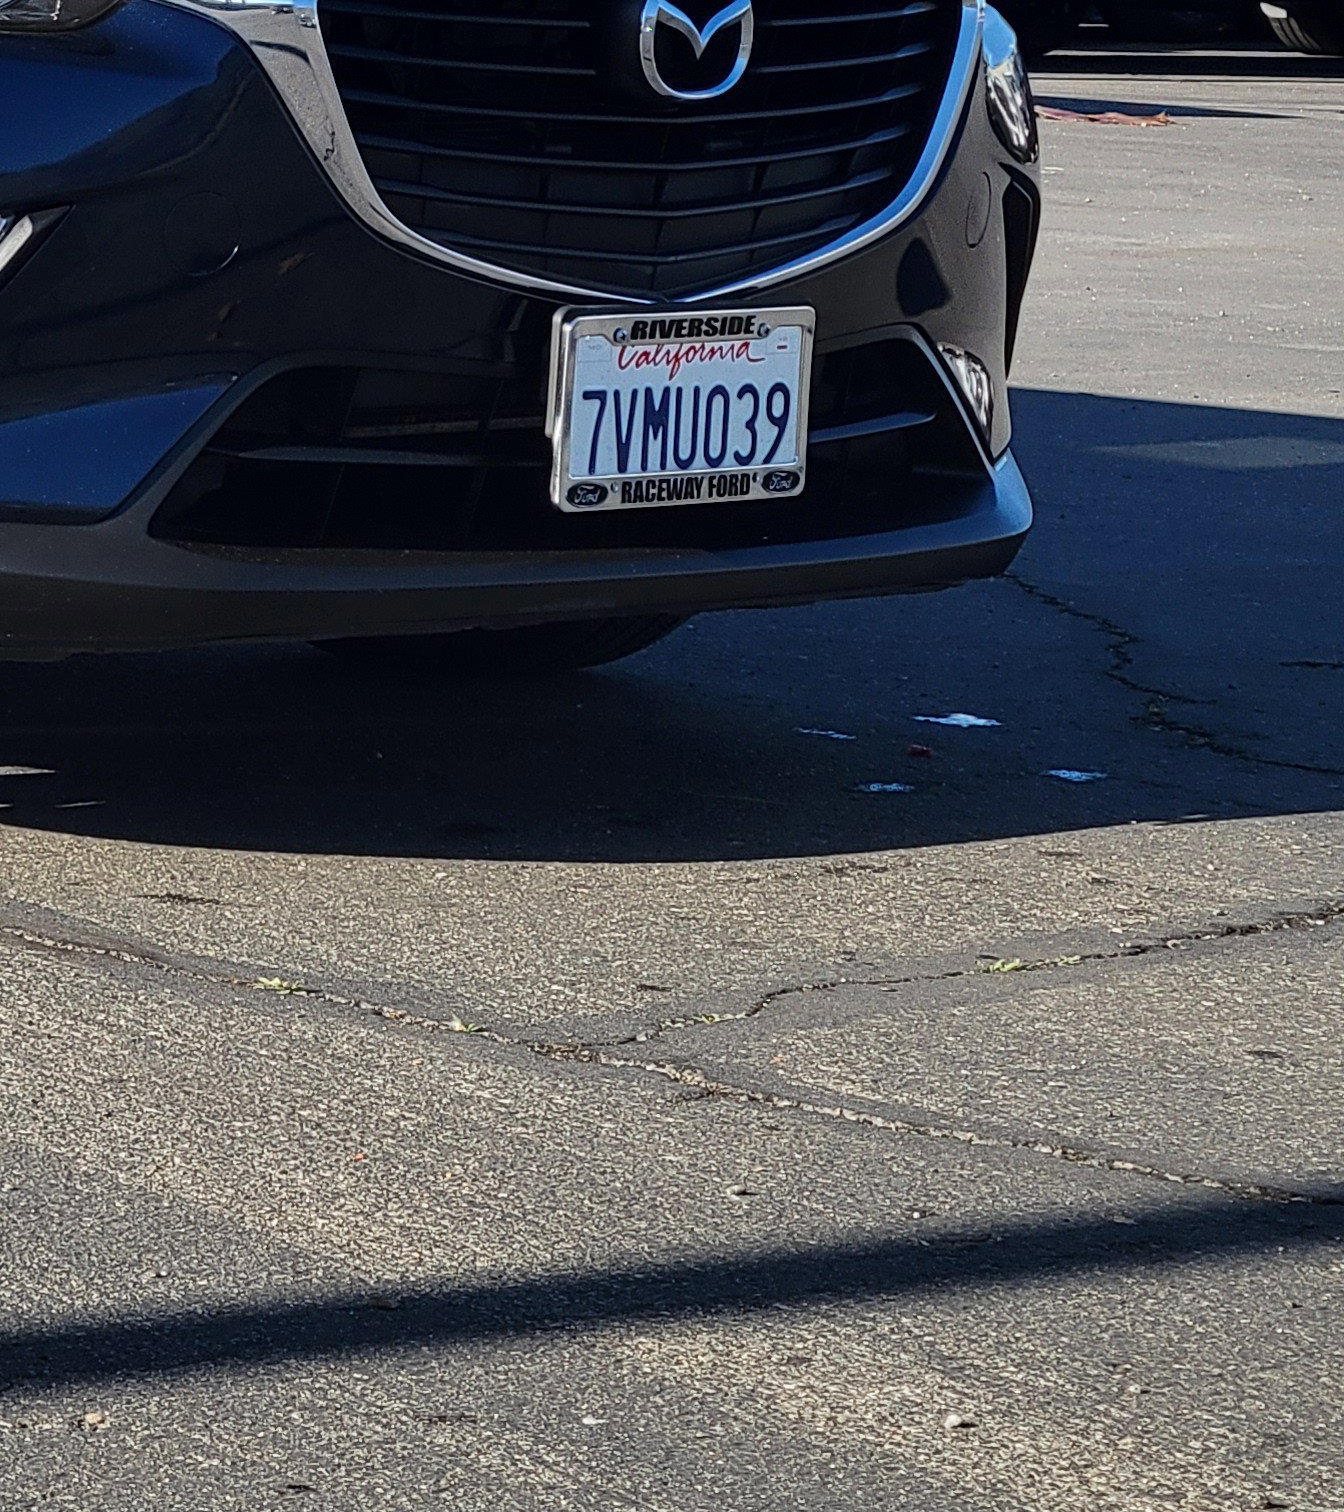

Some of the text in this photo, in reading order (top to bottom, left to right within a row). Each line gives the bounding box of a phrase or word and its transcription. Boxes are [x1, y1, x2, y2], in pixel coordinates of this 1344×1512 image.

[630, 315, 757, 340] RIVERSIDE
[617, 341, 766, 381] California
[582, 382, 791, 475] 7VMU039
[574, 488, 601, 503] Ford
[621, 473, 750, 504] RACEWAY FORD
[769, 476, 794, 491] Ford
